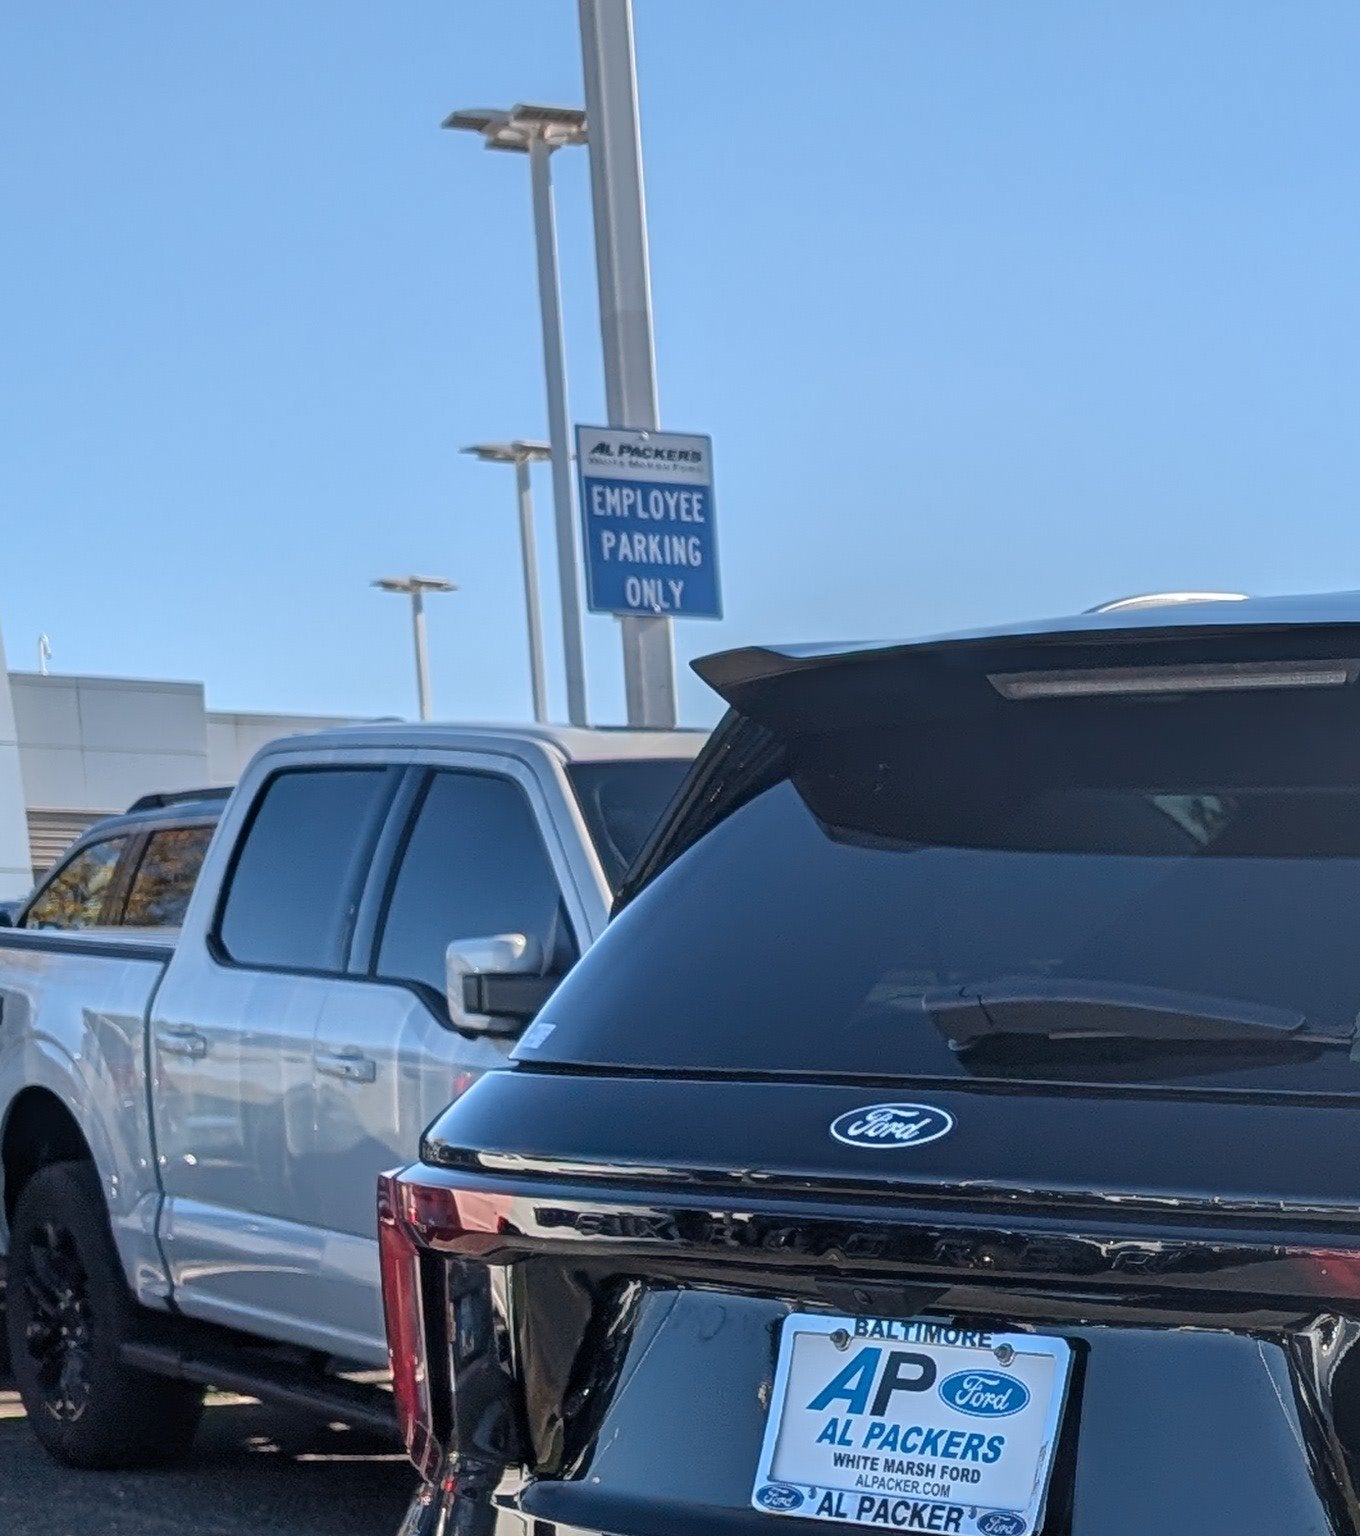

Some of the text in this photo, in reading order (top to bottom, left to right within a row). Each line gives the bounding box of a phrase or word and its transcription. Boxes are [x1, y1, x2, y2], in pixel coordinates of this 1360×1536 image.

[591, 443, 702, 463] AL PACKERS
[592, 485, 704, 523] EMPLOYEE
[601, 530, 702, 567] PARKING
[626, 576, 684, 609] ONLY
[848, 1108, 932, 1139] Ford
[854, 1318, 991, 1347] BALTIMORE
[806, 1347, 937, 1416] AP
[955, 1375, 1010, 1410] Ford
[815, 1418, 1005, 1463] AL PACKERS
[833, 1452, 981, 1484] WHITE MARSH FORD
[855, 1474, 951, 1497] ALPACKER.COM
[815, 1491, 964, 1532] AL PACKER
[985, 1515, 1015, 1534] Ford
